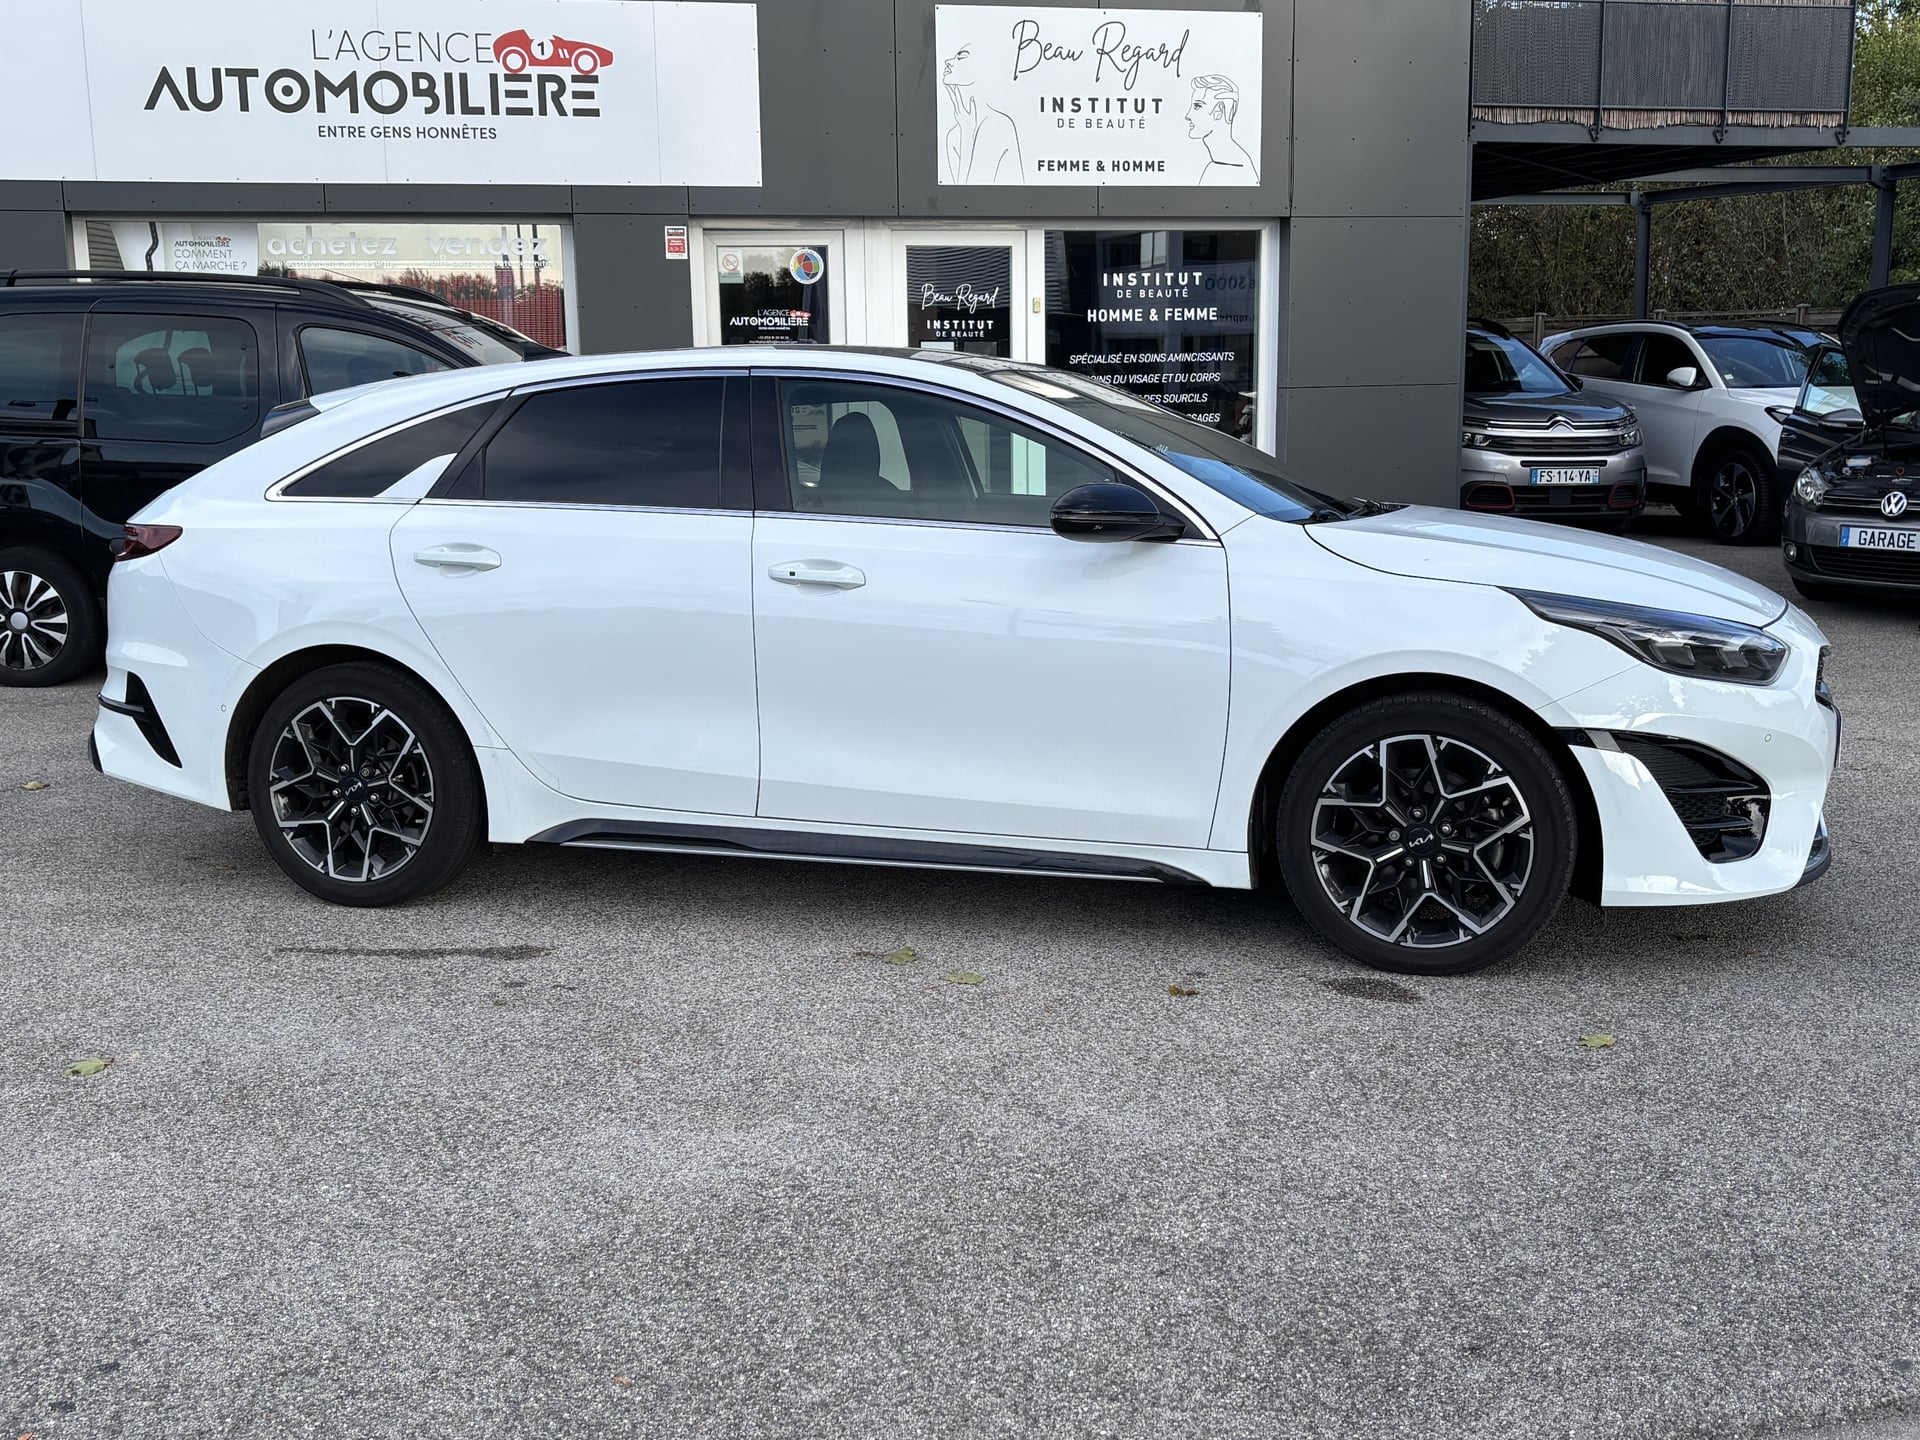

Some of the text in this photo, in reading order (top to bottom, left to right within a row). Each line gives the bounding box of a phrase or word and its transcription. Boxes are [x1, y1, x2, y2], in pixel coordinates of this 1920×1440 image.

[311, 29, 494, 63] L'AGENCE
[1012, 19, 1190, 91] Beau Regard
[1040, 97, 1163, 114] INSTITUT
[1057, 116, 1146, 129] DE BEAUTÉ
[318, 124, 497, 140] ENTRE GENS HONNÊTES
[1037, 160, 1166, 172] FEMME & HOMME
[267, 225, 397, 255] achetez
[425, 226, 547, 255] vendez
[174, 249, 232, 259] COMMENT
[175, 261, 193, 271] ÇA
[196, 261, 239, 270] MARCHE
[1103, 272, 1202, 286] INSTITUT
[921, 283, 999, 314] Beau Regard
[1116, 287, 1188, 298] DE BEAUTÉ
[1087, 308, 1143, 322] HOMME
[1149, 308, 1159, 321] &
[1164, 307, 1218, 321] FEMME
[927, 320, 994, 329] INSTITUT
[951, 330, 984, 338] BEAUTÉ
[1069, 352, 1235, 364] SPÉCIALISÉ EN SOINS AMINCISSANTS
[1113, 374, 1127, 385] DU
[1128, 373, 1160, 384] VISAGE
[1161, 373, 1173, 383] ET
[1174, 373, 1188, 383] DU
[1189, 372, 1221, 383] CORPS
[1162, 392, 1208, 403] SOURCILS
[1858, 530, 1917, 549] GARAGE
